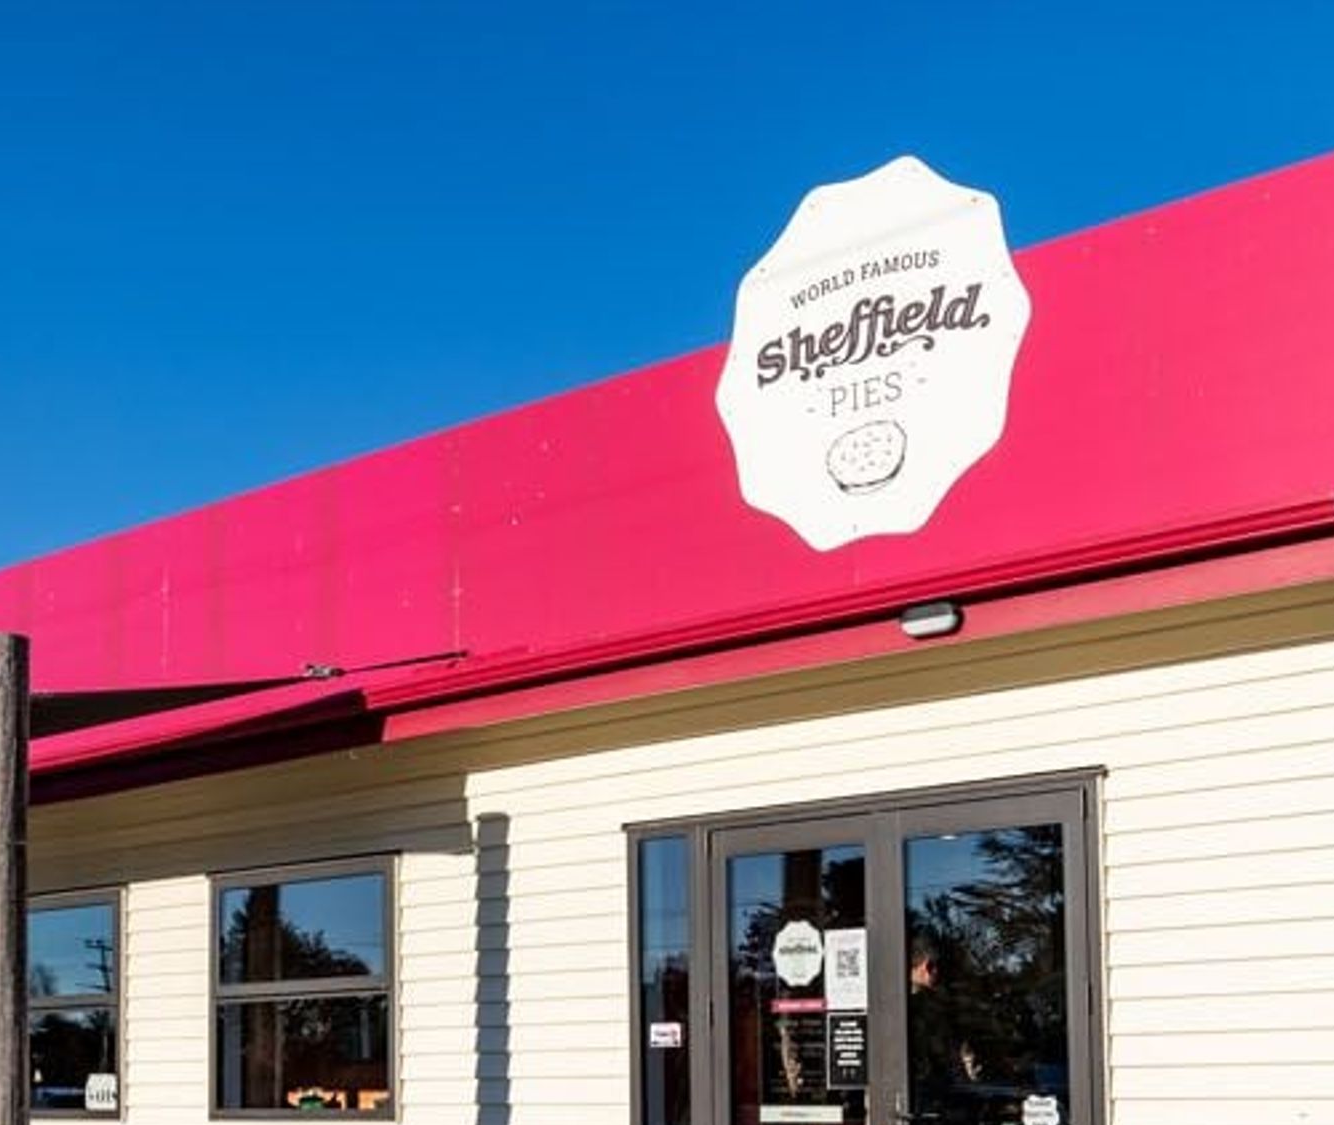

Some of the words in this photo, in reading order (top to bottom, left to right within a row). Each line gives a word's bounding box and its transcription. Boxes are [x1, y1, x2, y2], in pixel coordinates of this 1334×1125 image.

[790, 270, 855, 310] WORLD
[861, 250, 941, 283] FAMOUS
[830, 371, 903, 417] PIES
